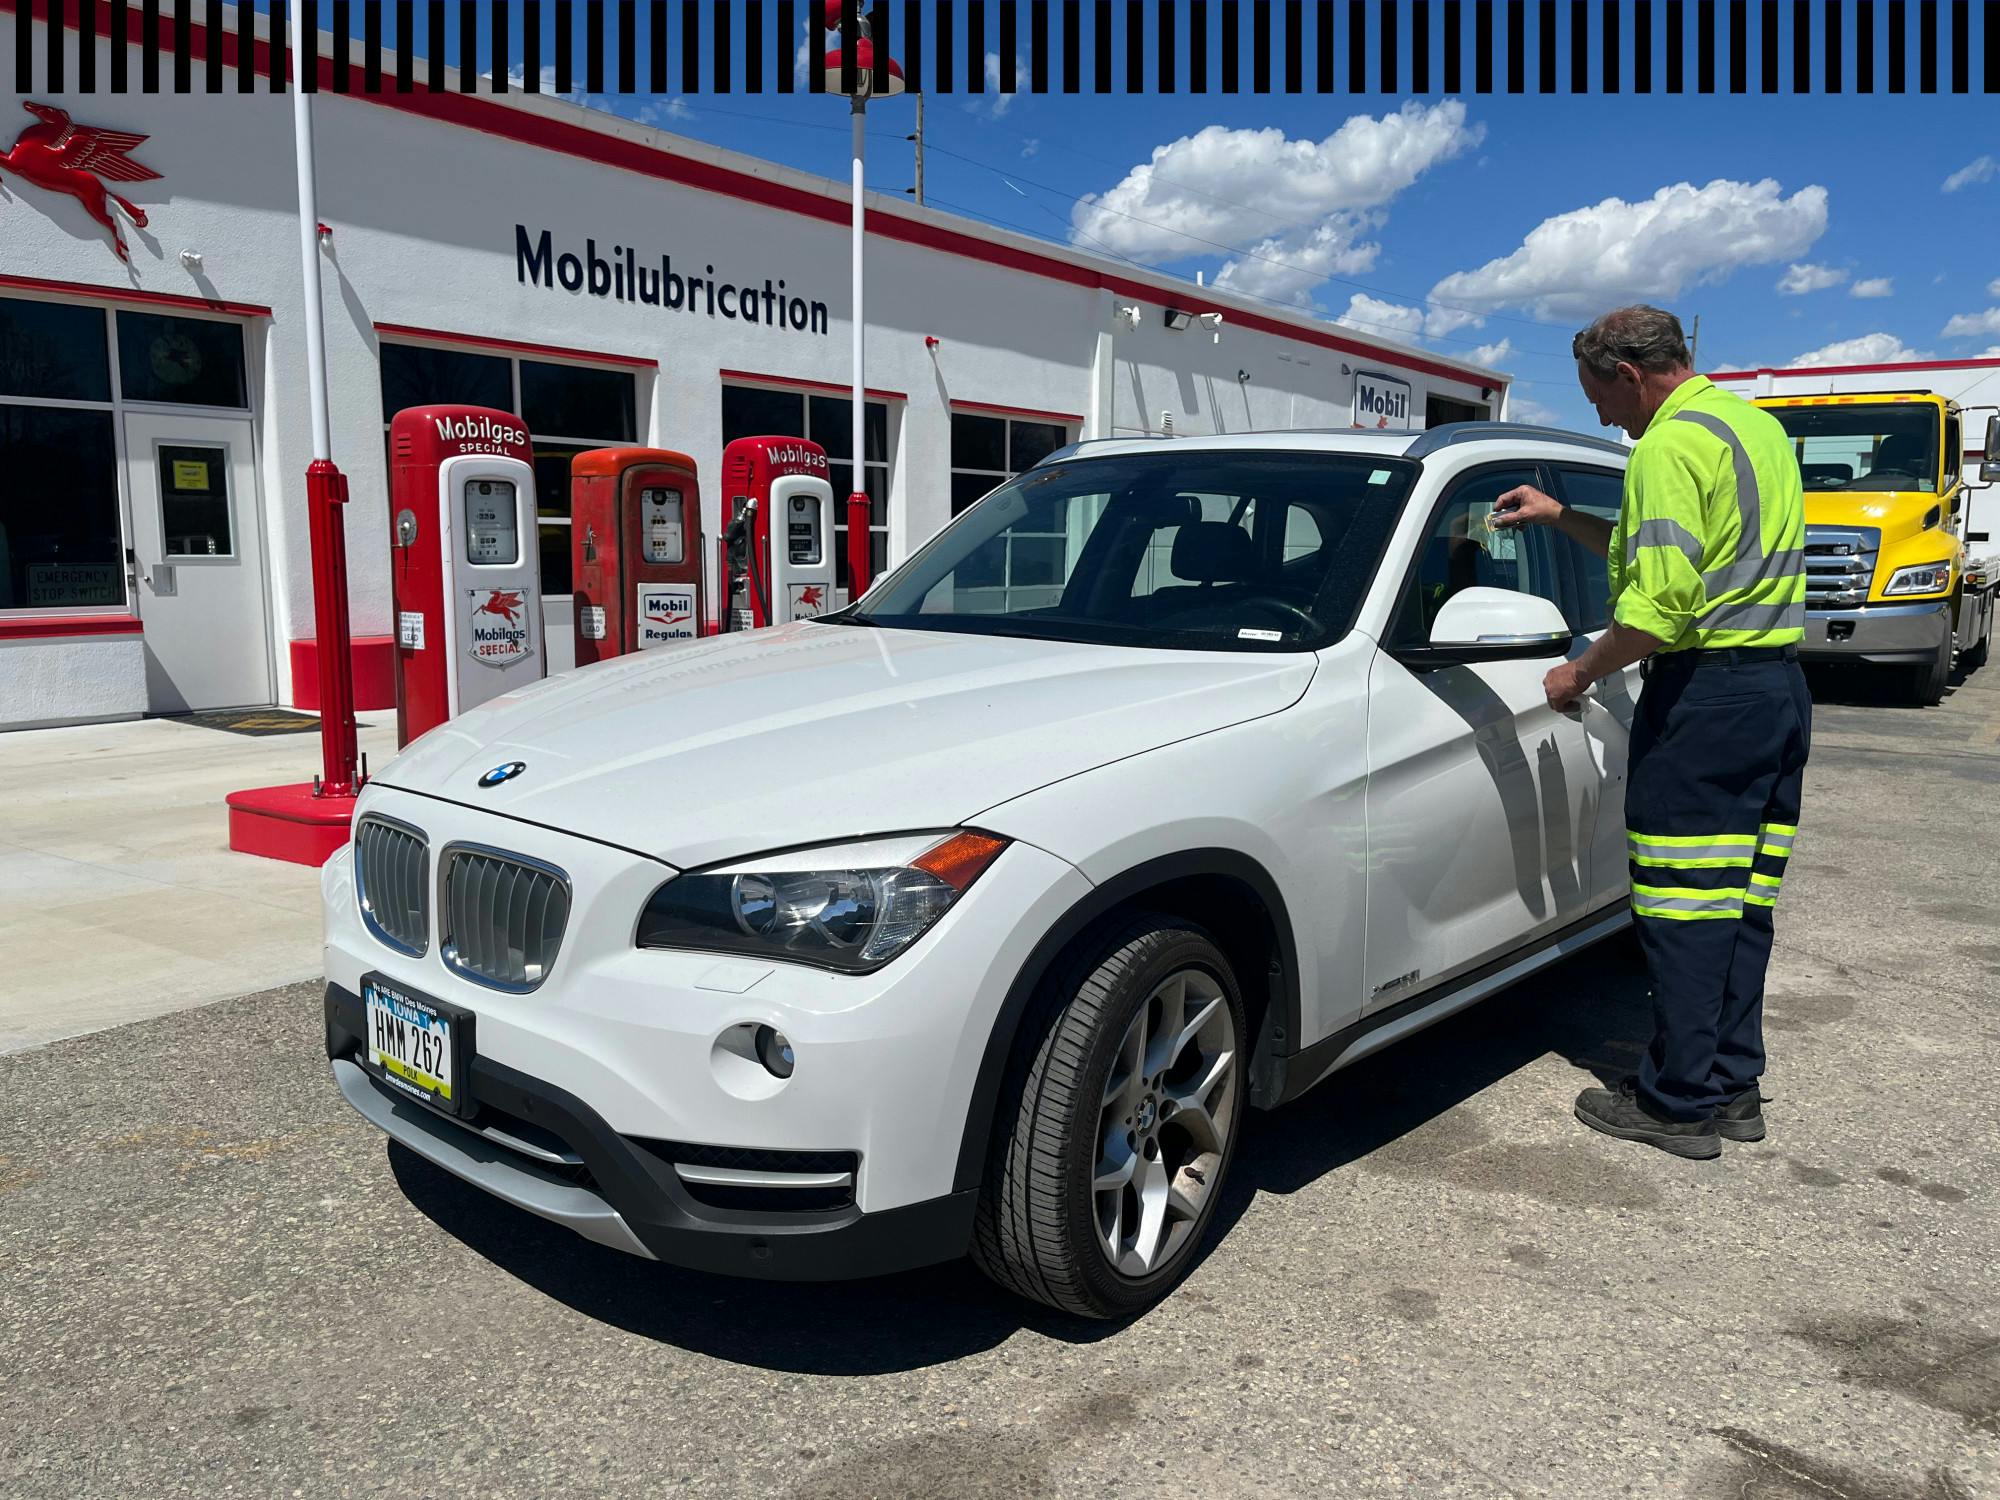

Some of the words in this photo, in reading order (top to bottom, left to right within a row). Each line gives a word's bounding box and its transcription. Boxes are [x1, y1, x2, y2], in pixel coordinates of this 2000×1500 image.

[516, 224, 827, 334] Mobilubrication
[1360, 385, 1405, 418] Mobil
[435, 416, 525, 445] Mobilgas
[459, 443, 511, 456] SPECIAL
[767, 444, 826, 468] Mobilgas
[36, 570, 109, 584] EMERGENCY
[32, 587, 65, 601] STOP
[71, 585, 115, 600] SWITCH
[648, 599, 688, 611] Mobil
[474, 627, 525, 643] Mobilgas
[480, 644, 521, 656] SPECIAL
[393, 1000, 420, 1024] IOWA
[404, 997, 416, 1009] Des
[416, 1001, 437, 1017] Moines
[375, 1008, 406, 1061] HMM
[412, 1026, 444, 1079] 262
[403, 1065, 418, 1081] POLK
[385, 1072, 431, 1101] bmwdesmoines.com
